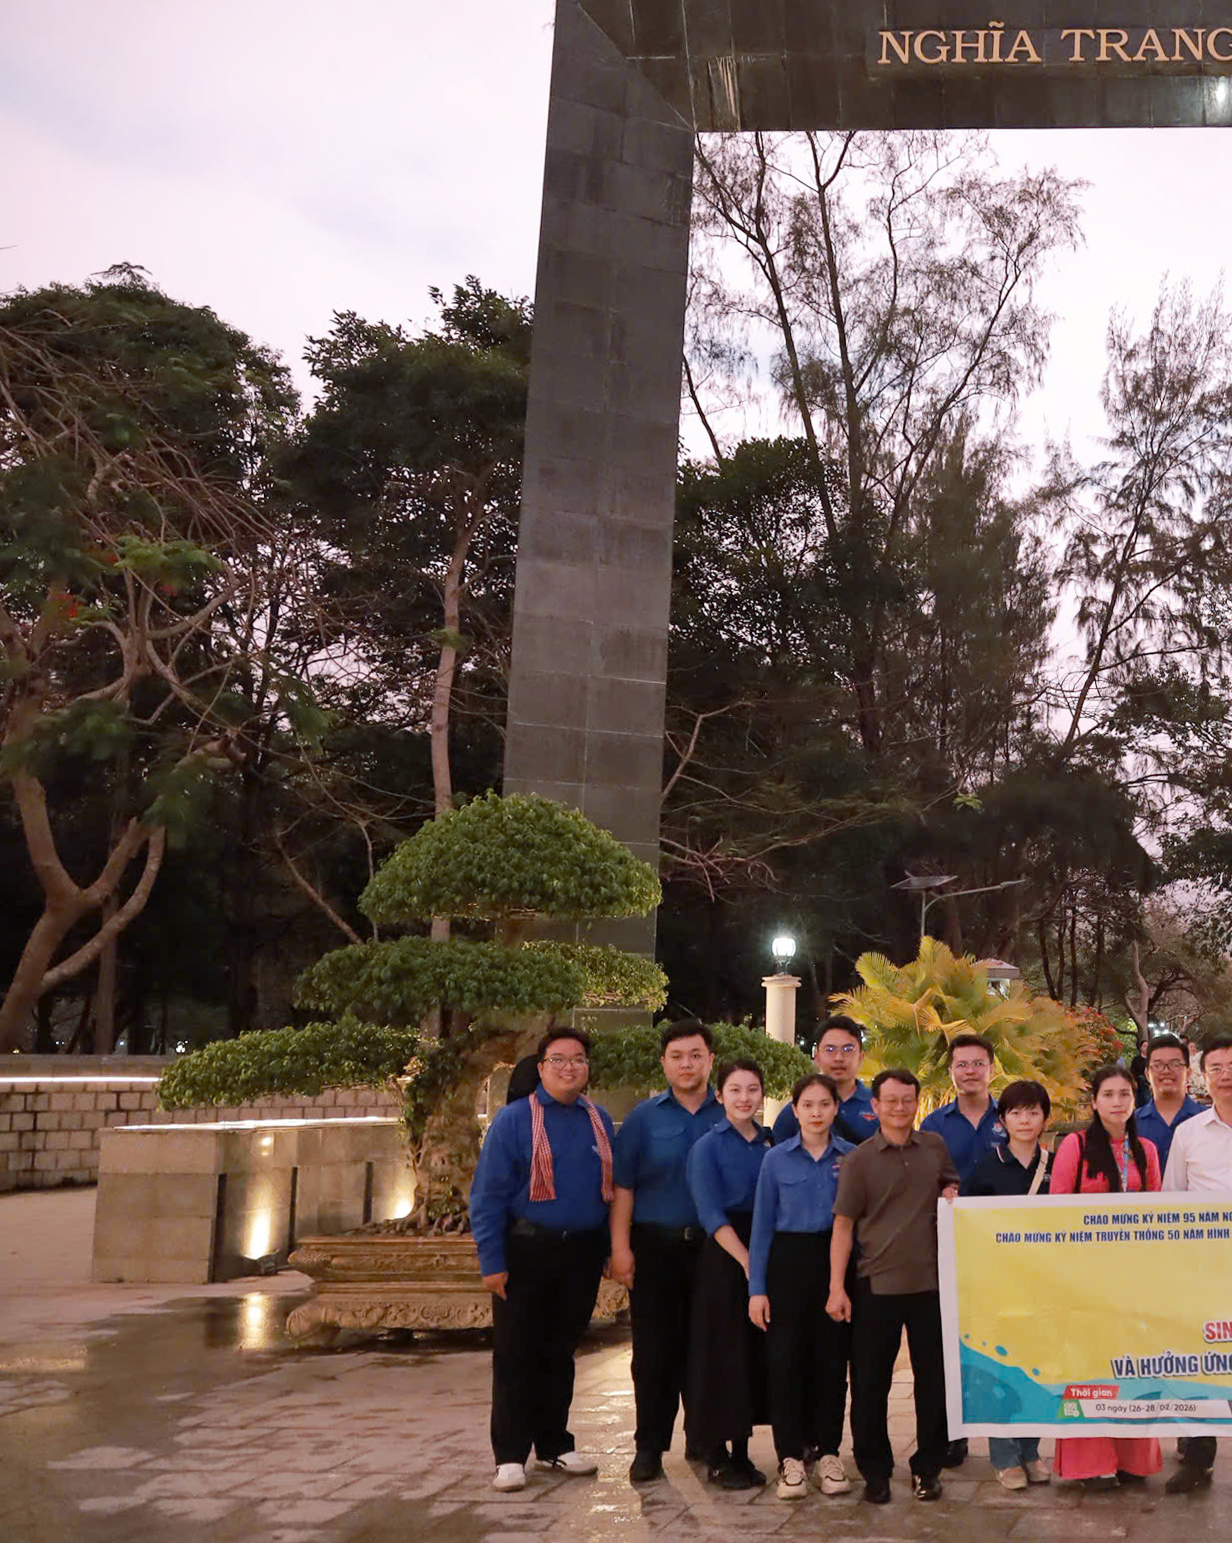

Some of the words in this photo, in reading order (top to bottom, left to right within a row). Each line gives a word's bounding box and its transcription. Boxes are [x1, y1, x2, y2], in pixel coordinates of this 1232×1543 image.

[877, 20, 1043, 65] NGHĨA
[1182, 1212, 1196, 1223] 95
[1167, 1229, 1180, 1240] 50
[1113, 1356, 1136, 1378] VÀ
[1139, 1350, 1199, 1375] HƯỞNG
[1093, 1388, 1113, 1399] gian
[1095, 1403, 1106, 1411] 03
